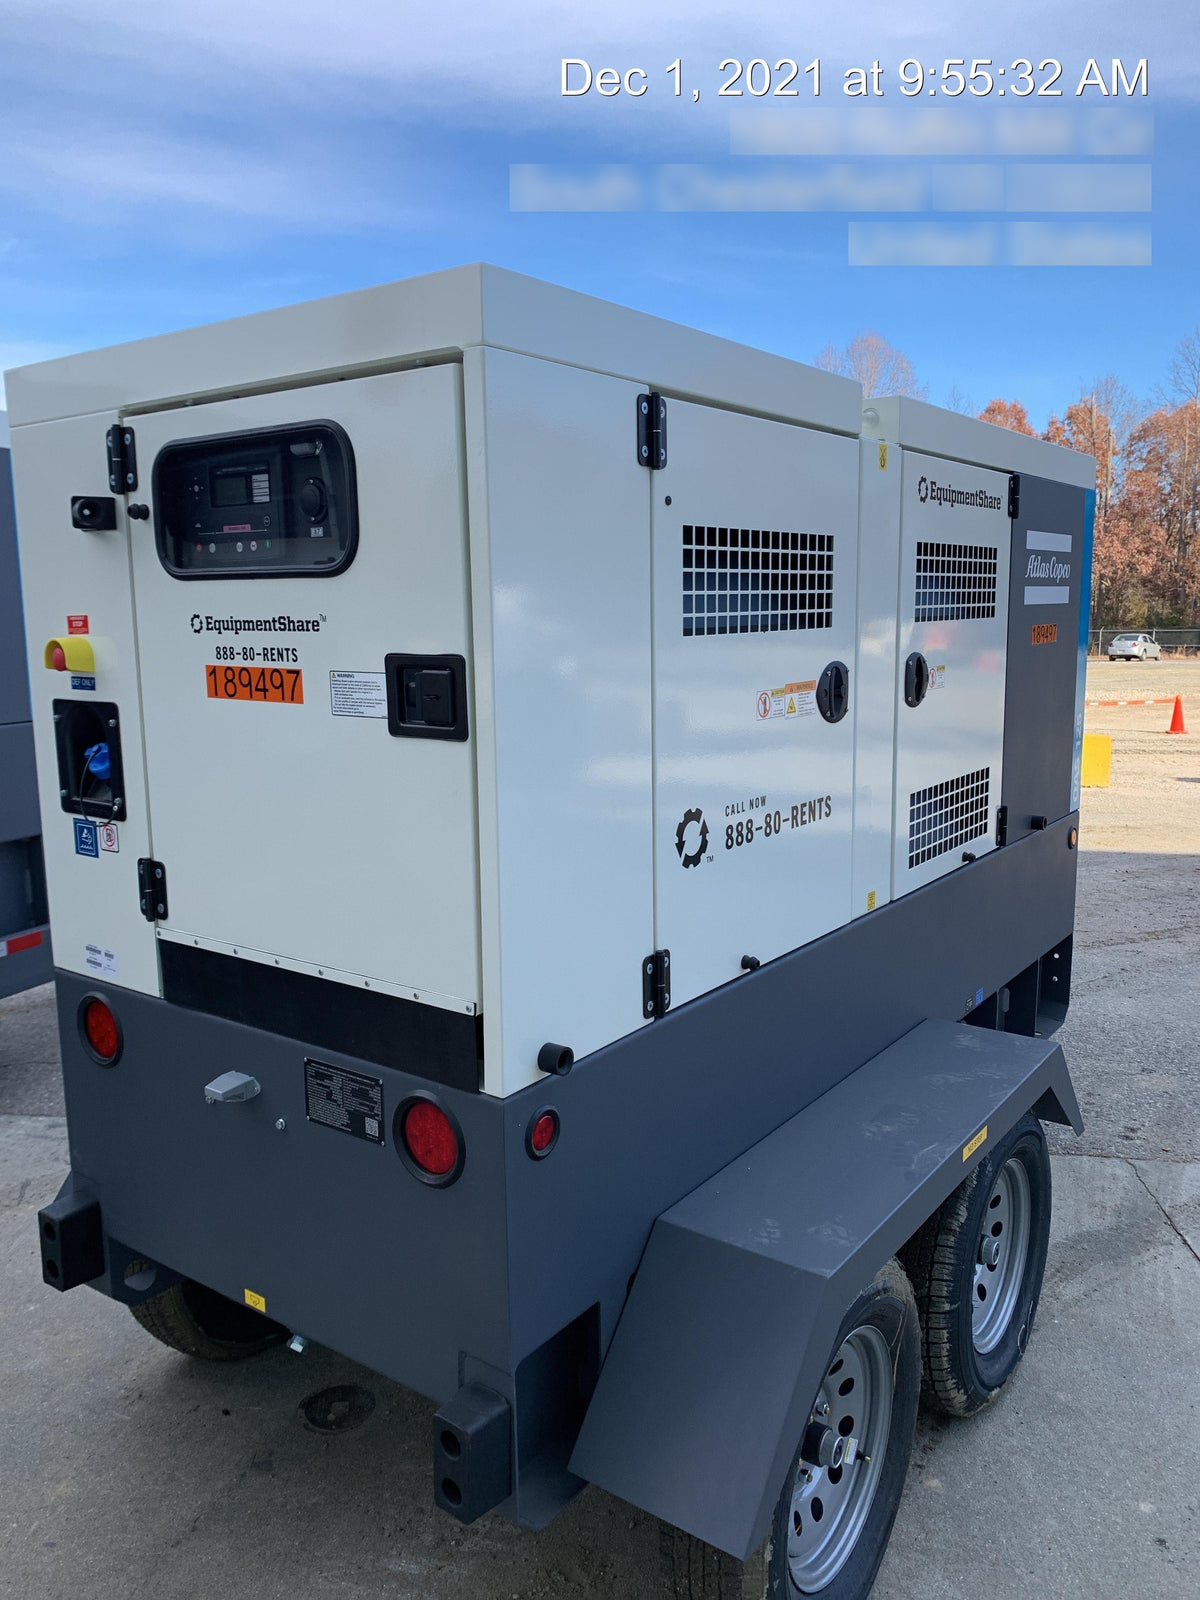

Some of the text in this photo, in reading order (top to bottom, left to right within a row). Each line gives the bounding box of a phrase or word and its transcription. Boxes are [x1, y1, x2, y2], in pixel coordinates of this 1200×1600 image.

[929, 481, 1001, 510] EquipmentShare
[205, 616, 320, 634] EquipmentShare
[1032, 625, 1057, 643] 189497
[215, 646, 299, 662] 888-80-RENTS
[208, 666, 301, 701] 189497
[725, 795, 767, 817] CALL NOW
[725, 795, 832, 850] 888-80-RENTS
